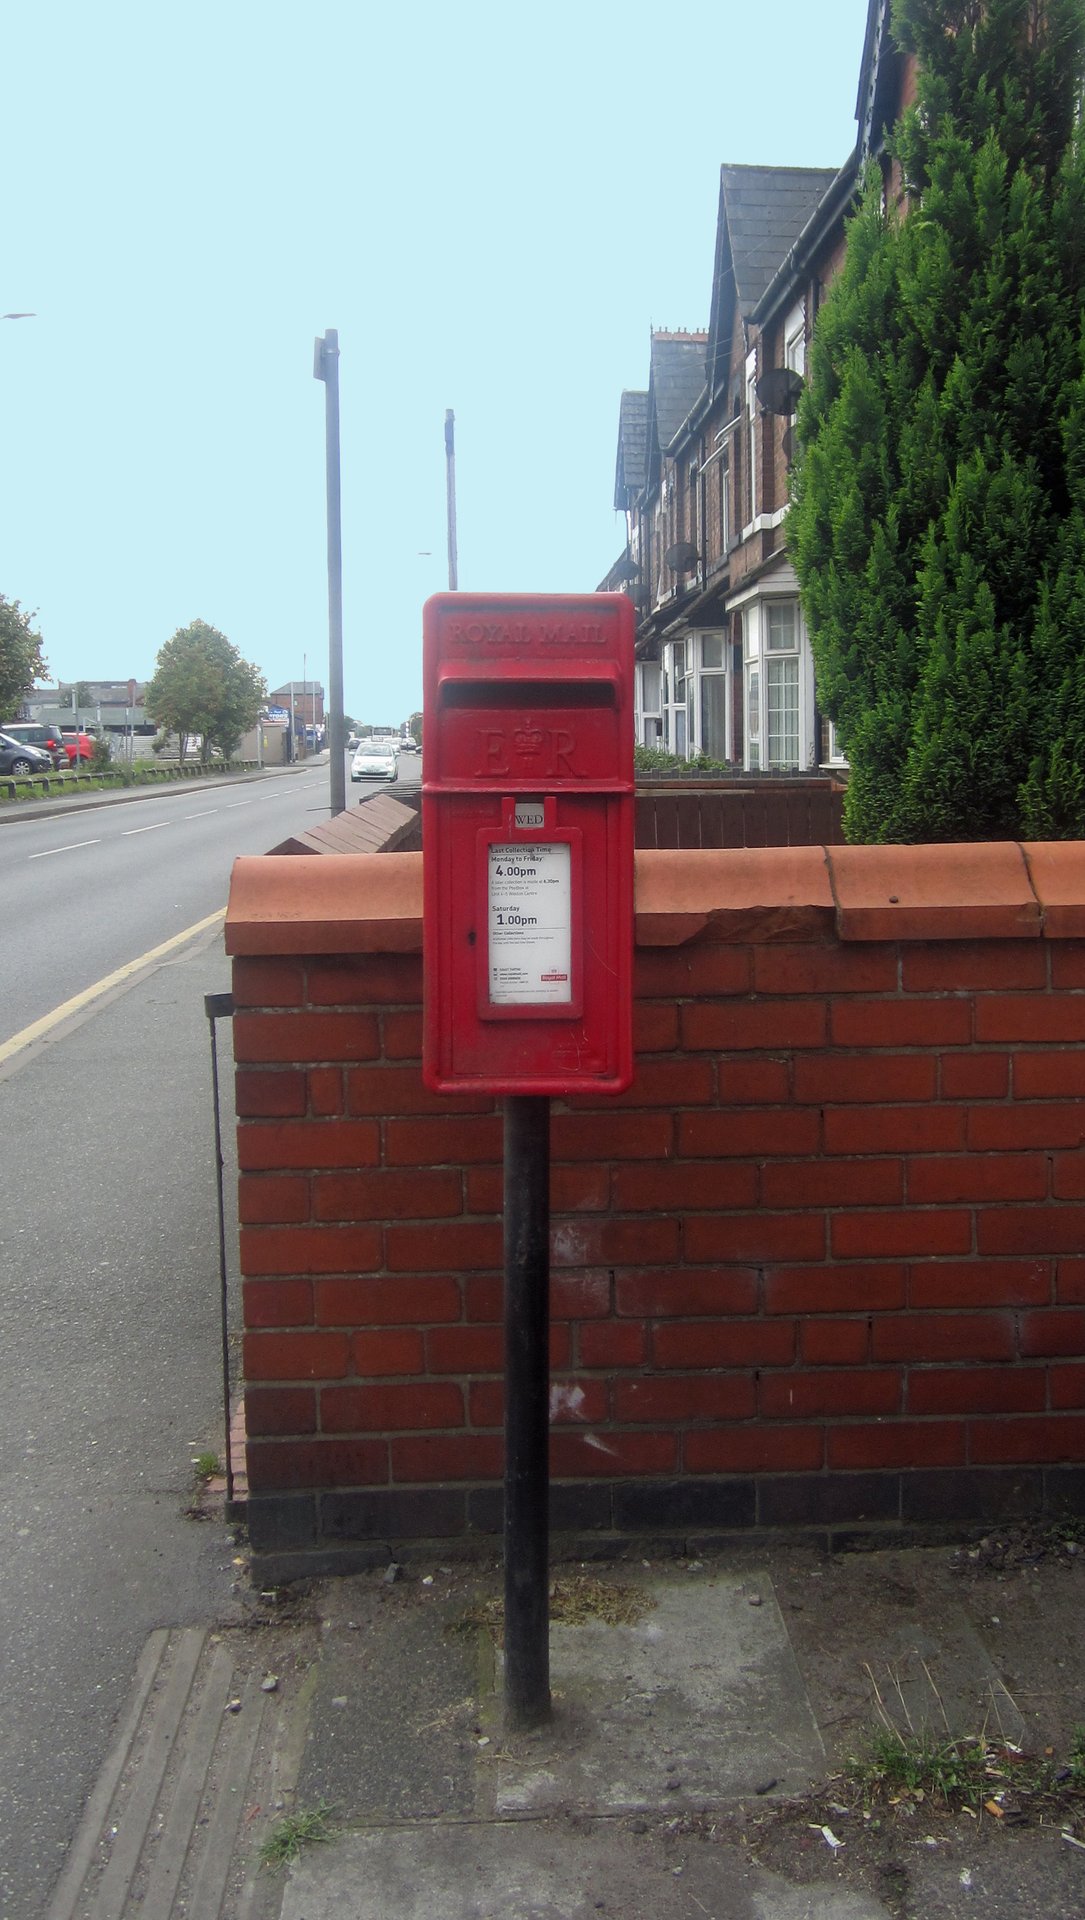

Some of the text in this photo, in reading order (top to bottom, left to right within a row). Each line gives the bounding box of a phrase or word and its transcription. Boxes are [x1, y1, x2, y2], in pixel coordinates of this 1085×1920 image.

[448, 623, 608, 645] ROYAL MAIL
[515, 814, 544, 825] WED
[491, 856, 515, 864] Monday
[495, 865, 536, 878] 4.00pm
[496, 913, 537, 926] 1.00pm
